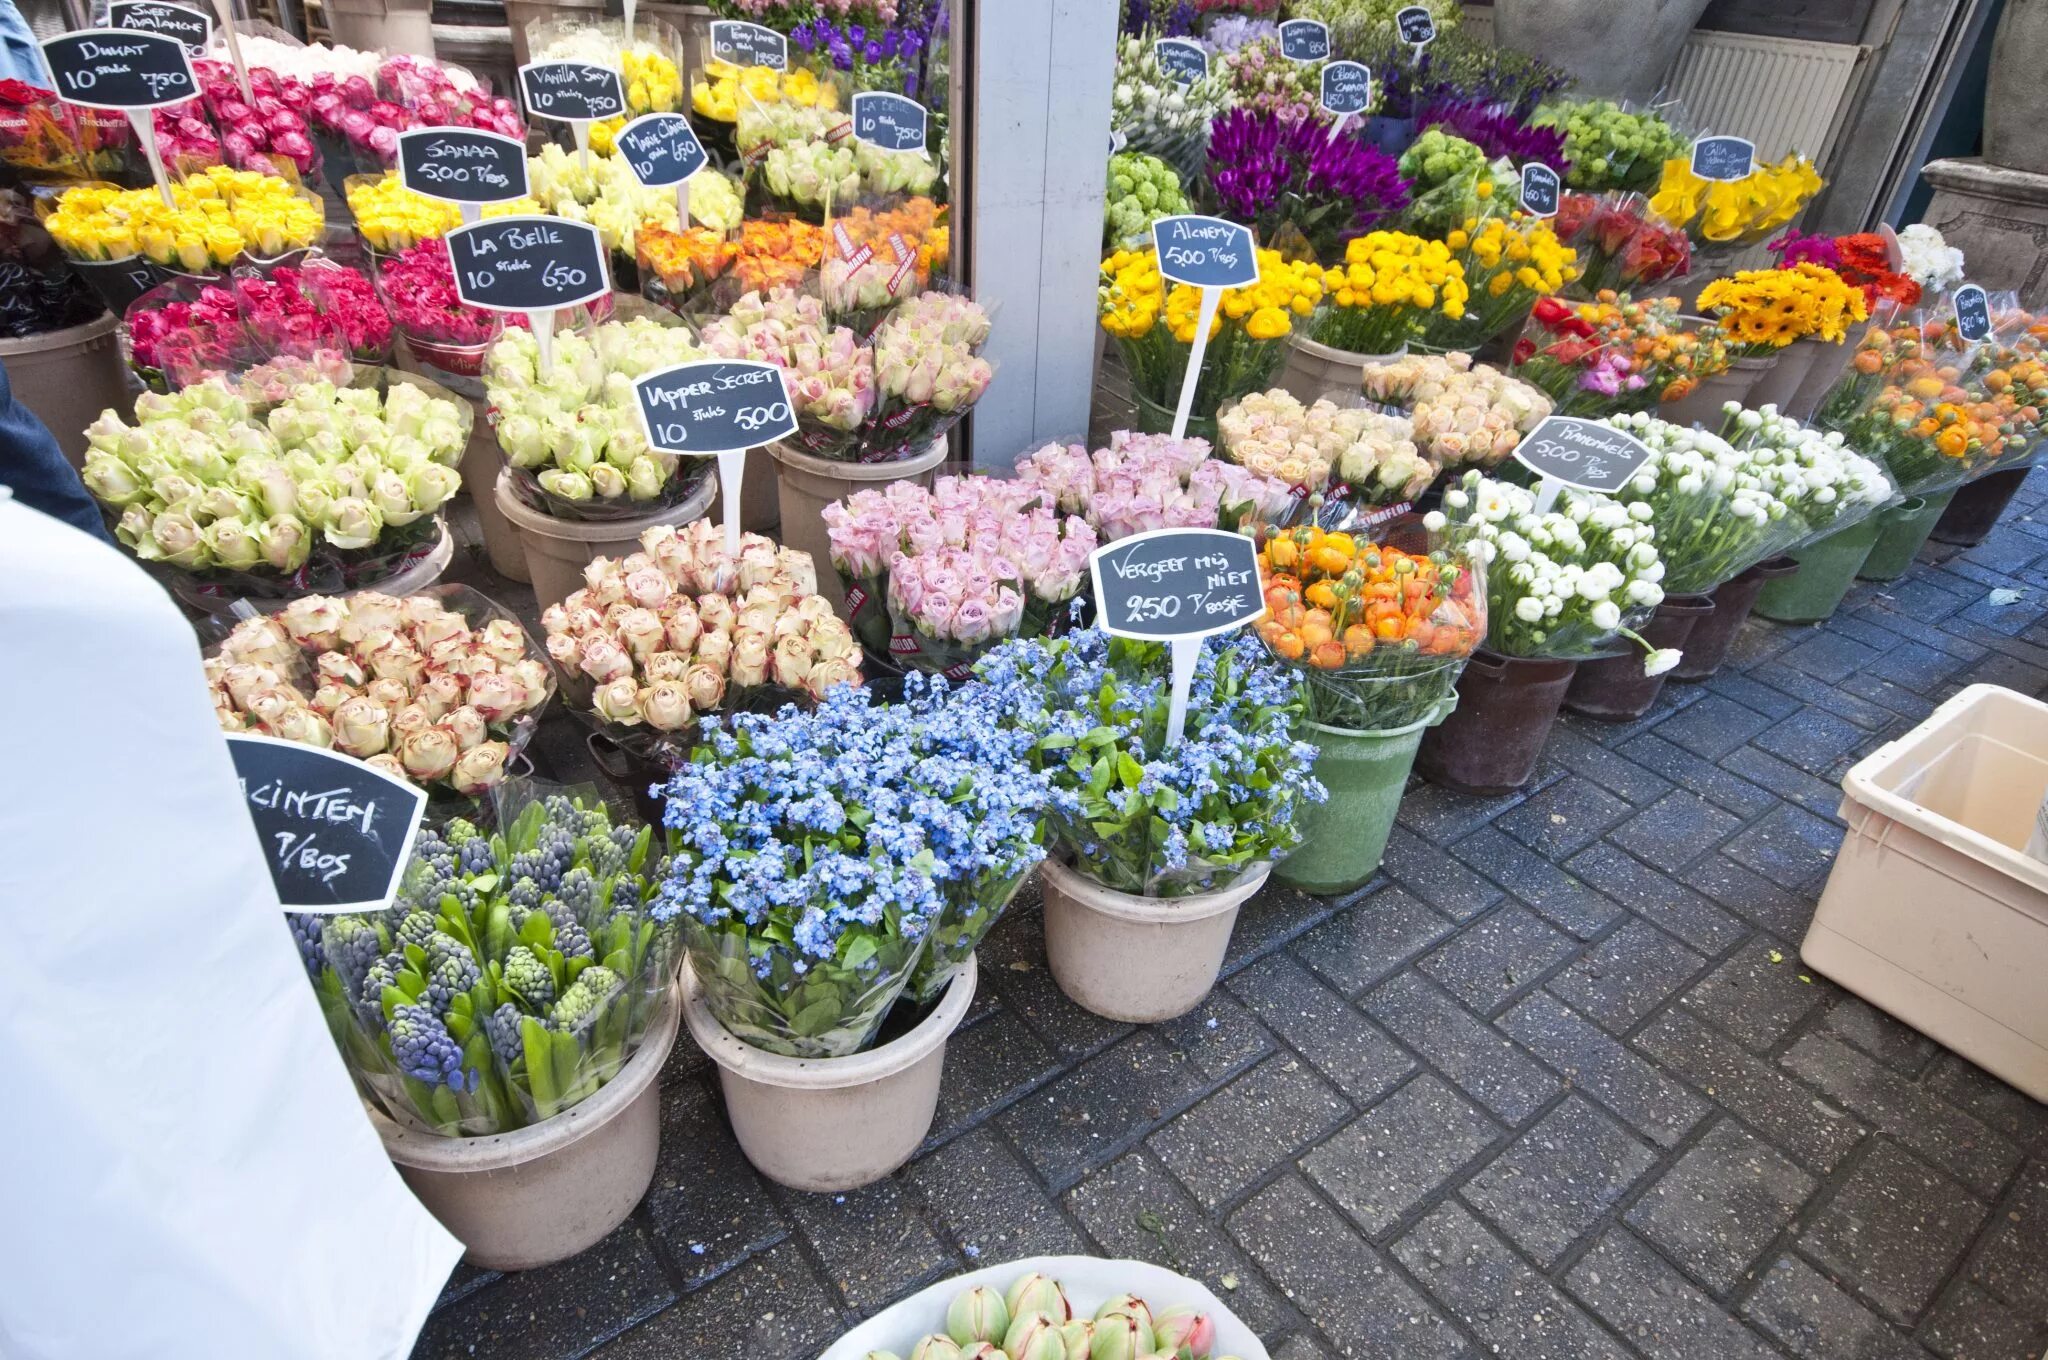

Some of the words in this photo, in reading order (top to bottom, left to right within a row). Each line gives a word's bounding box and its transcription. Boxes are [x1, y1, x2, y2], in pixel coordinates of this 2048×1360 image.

[131, 4, 175, 17] SWEET
[717, 40, 732, 53] 10
[65, 70, 96, 90] 10
[534, 92, 554, 109] 10
[862, 116, 876, 132] 10
[425, 139, 499, 159] SANAA
[634, 160, 653, 179] 10
[468, 232, 498, 257] LA
[467, 271, 495, 289] 10
[712, 365, 776, 390] SECRET
[656, 423, 687, 444] 10
